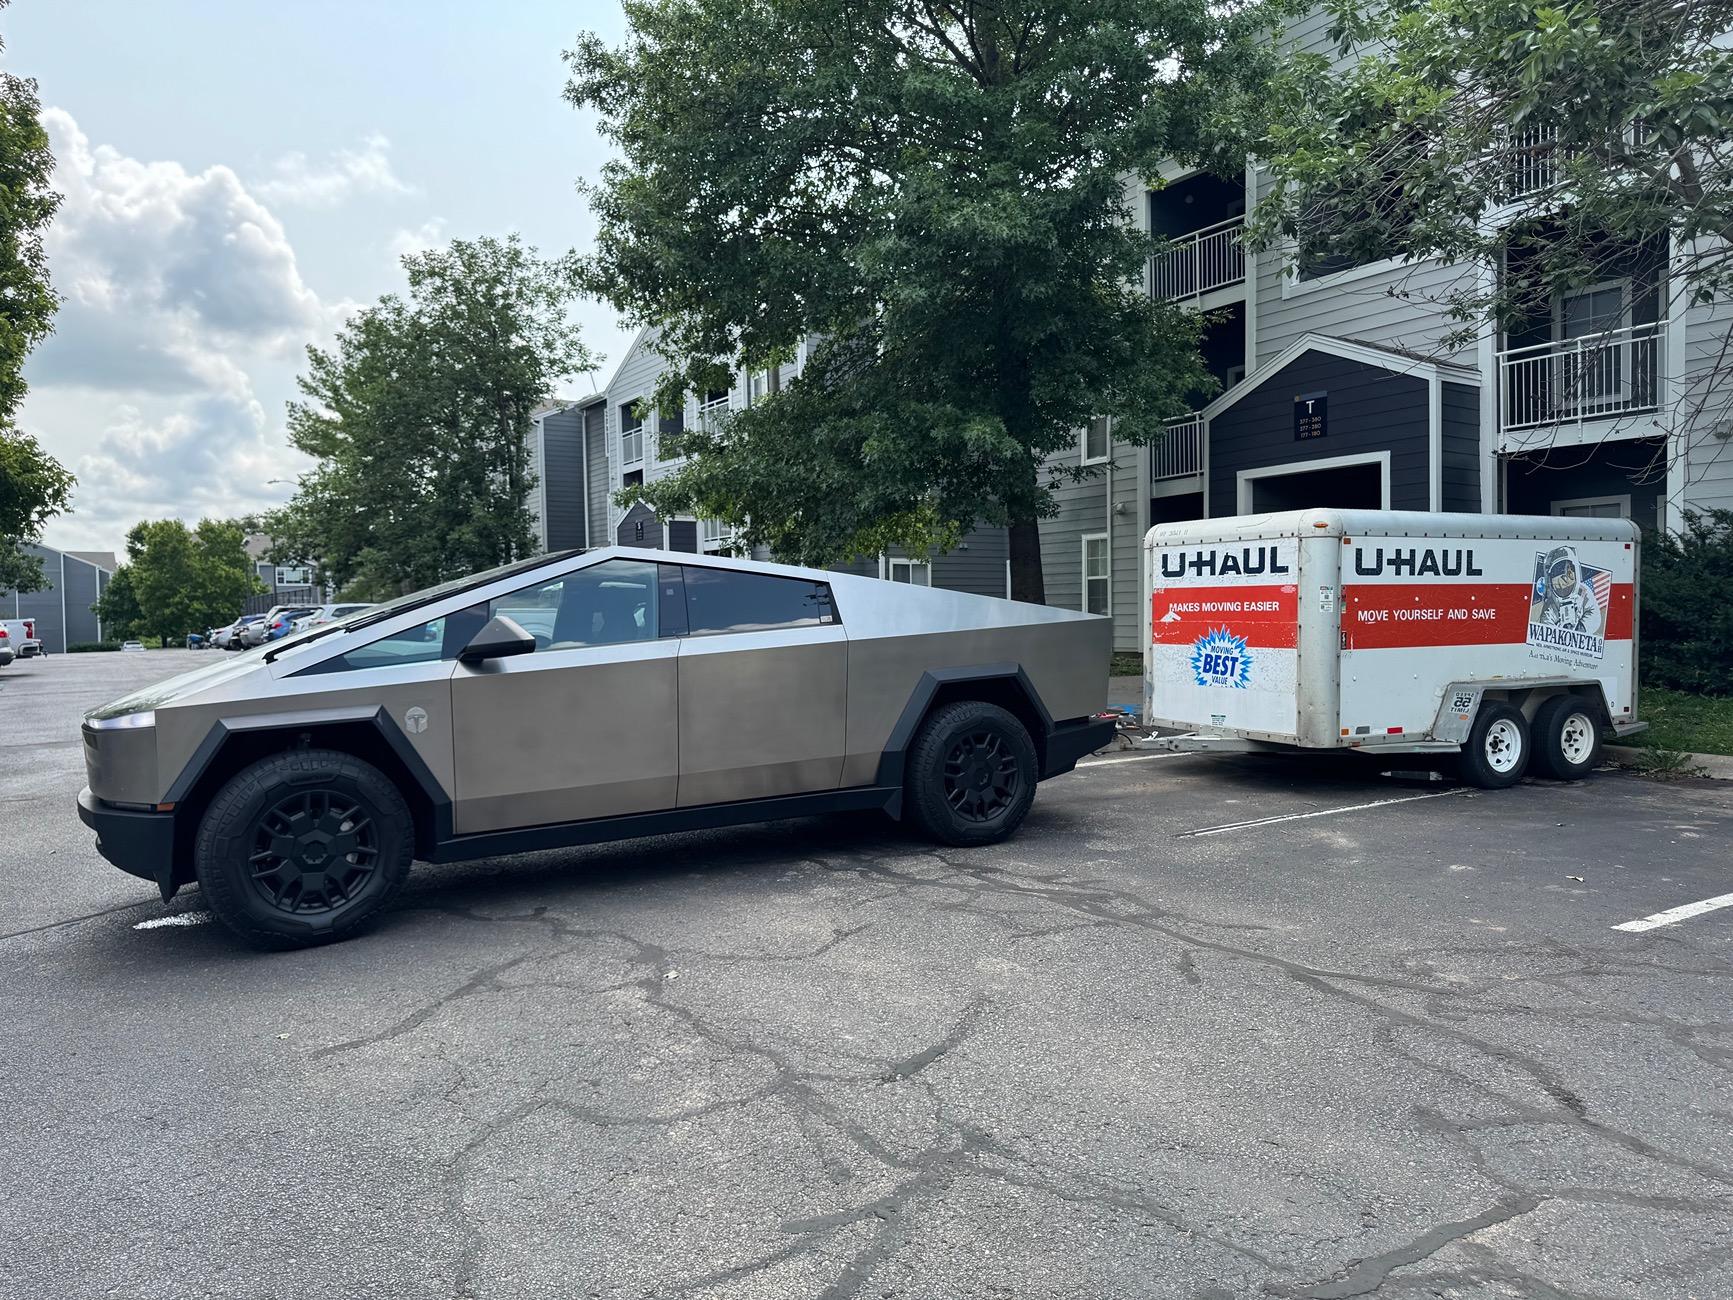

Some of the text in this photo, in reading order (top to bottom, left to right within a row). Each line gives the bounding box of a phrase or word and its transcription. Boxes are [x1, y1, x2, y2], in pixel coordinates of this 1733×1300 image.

[1306, 400, 1315, 414] T
[1161, 546, 1289, 577] U-HAUL
[1355, 548, 1482, 576] U-HAUL
[1169, 601, 1280, 612] MAKES MOVING EASIER
[1358, 609, 1496, 621] MOVE YOURSELF AND SAVE
[1529, 623, 1598, 653] WAPAKONETA
[1210, 645, 1234, 656] MOVING
[1202, 653, 1239, 677] BEST
[1211, 676, 1228, 685] VALUE
